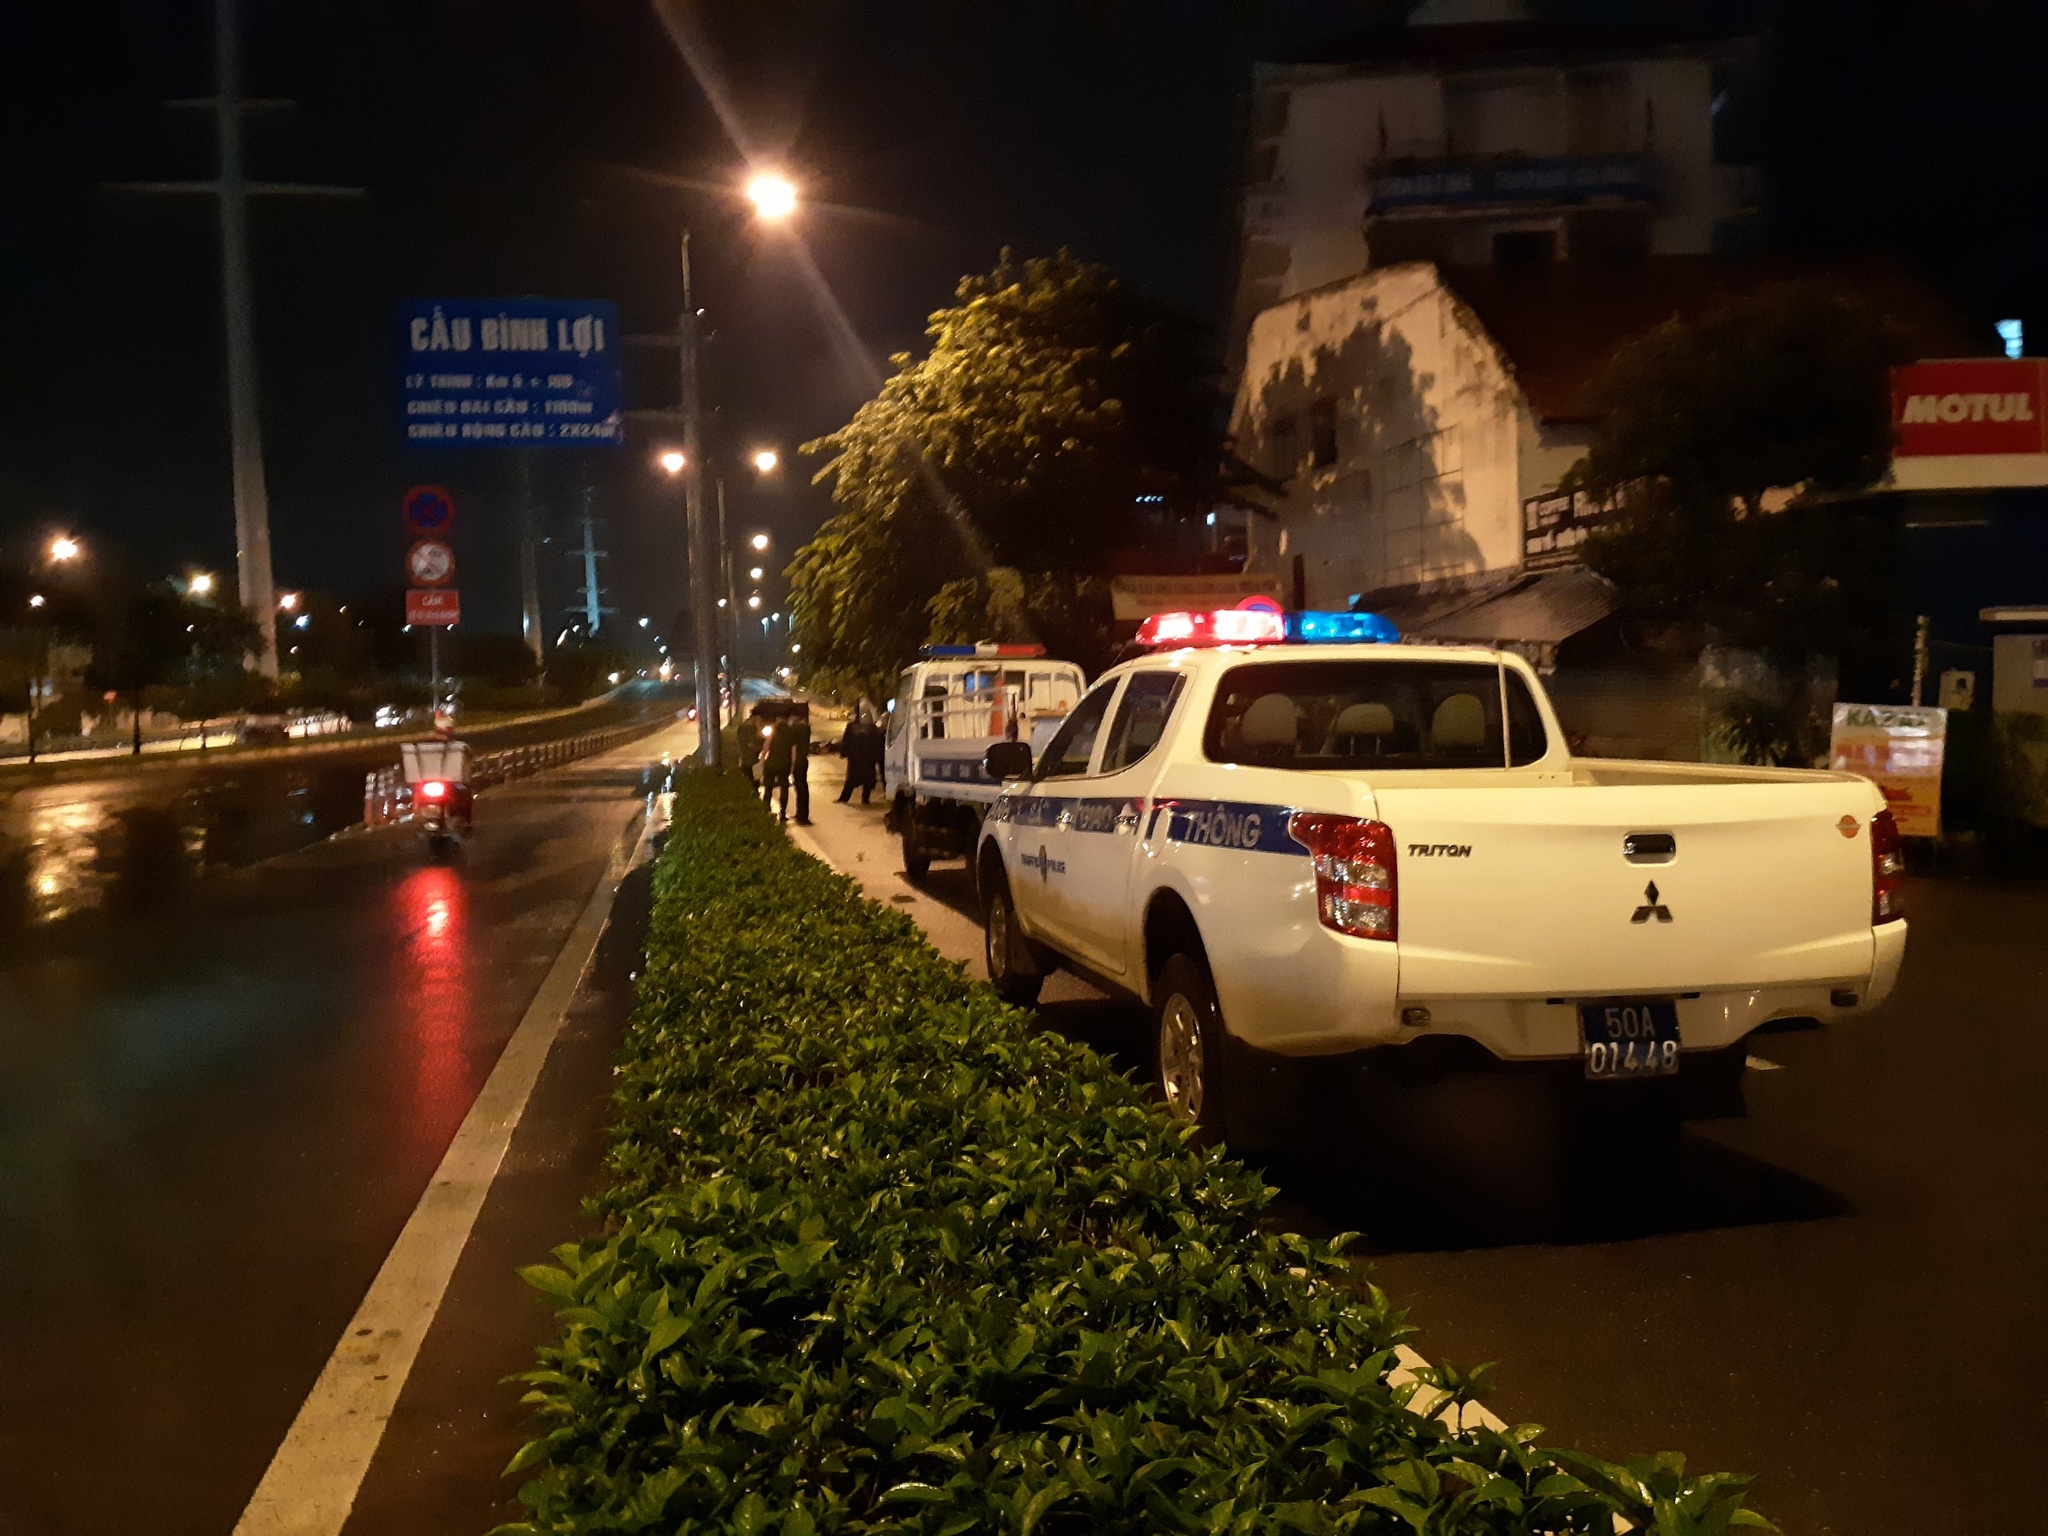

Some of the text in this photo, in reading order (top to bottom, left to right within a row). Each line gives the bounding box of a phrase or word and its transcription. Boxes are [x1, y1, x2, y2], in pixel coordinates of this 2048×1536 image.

[410, 305, 606, 358] CẦU BÌNH LỢI
[1902, 393, 2034, 424] MOTUL
[1184, 804, 1263, 848] THÔNG
[1408, 844, 1472, 859] TRITON
[1605, 1006, 1656, 1038] 50A
[1590, 1040, 1678, 1074] 01448
